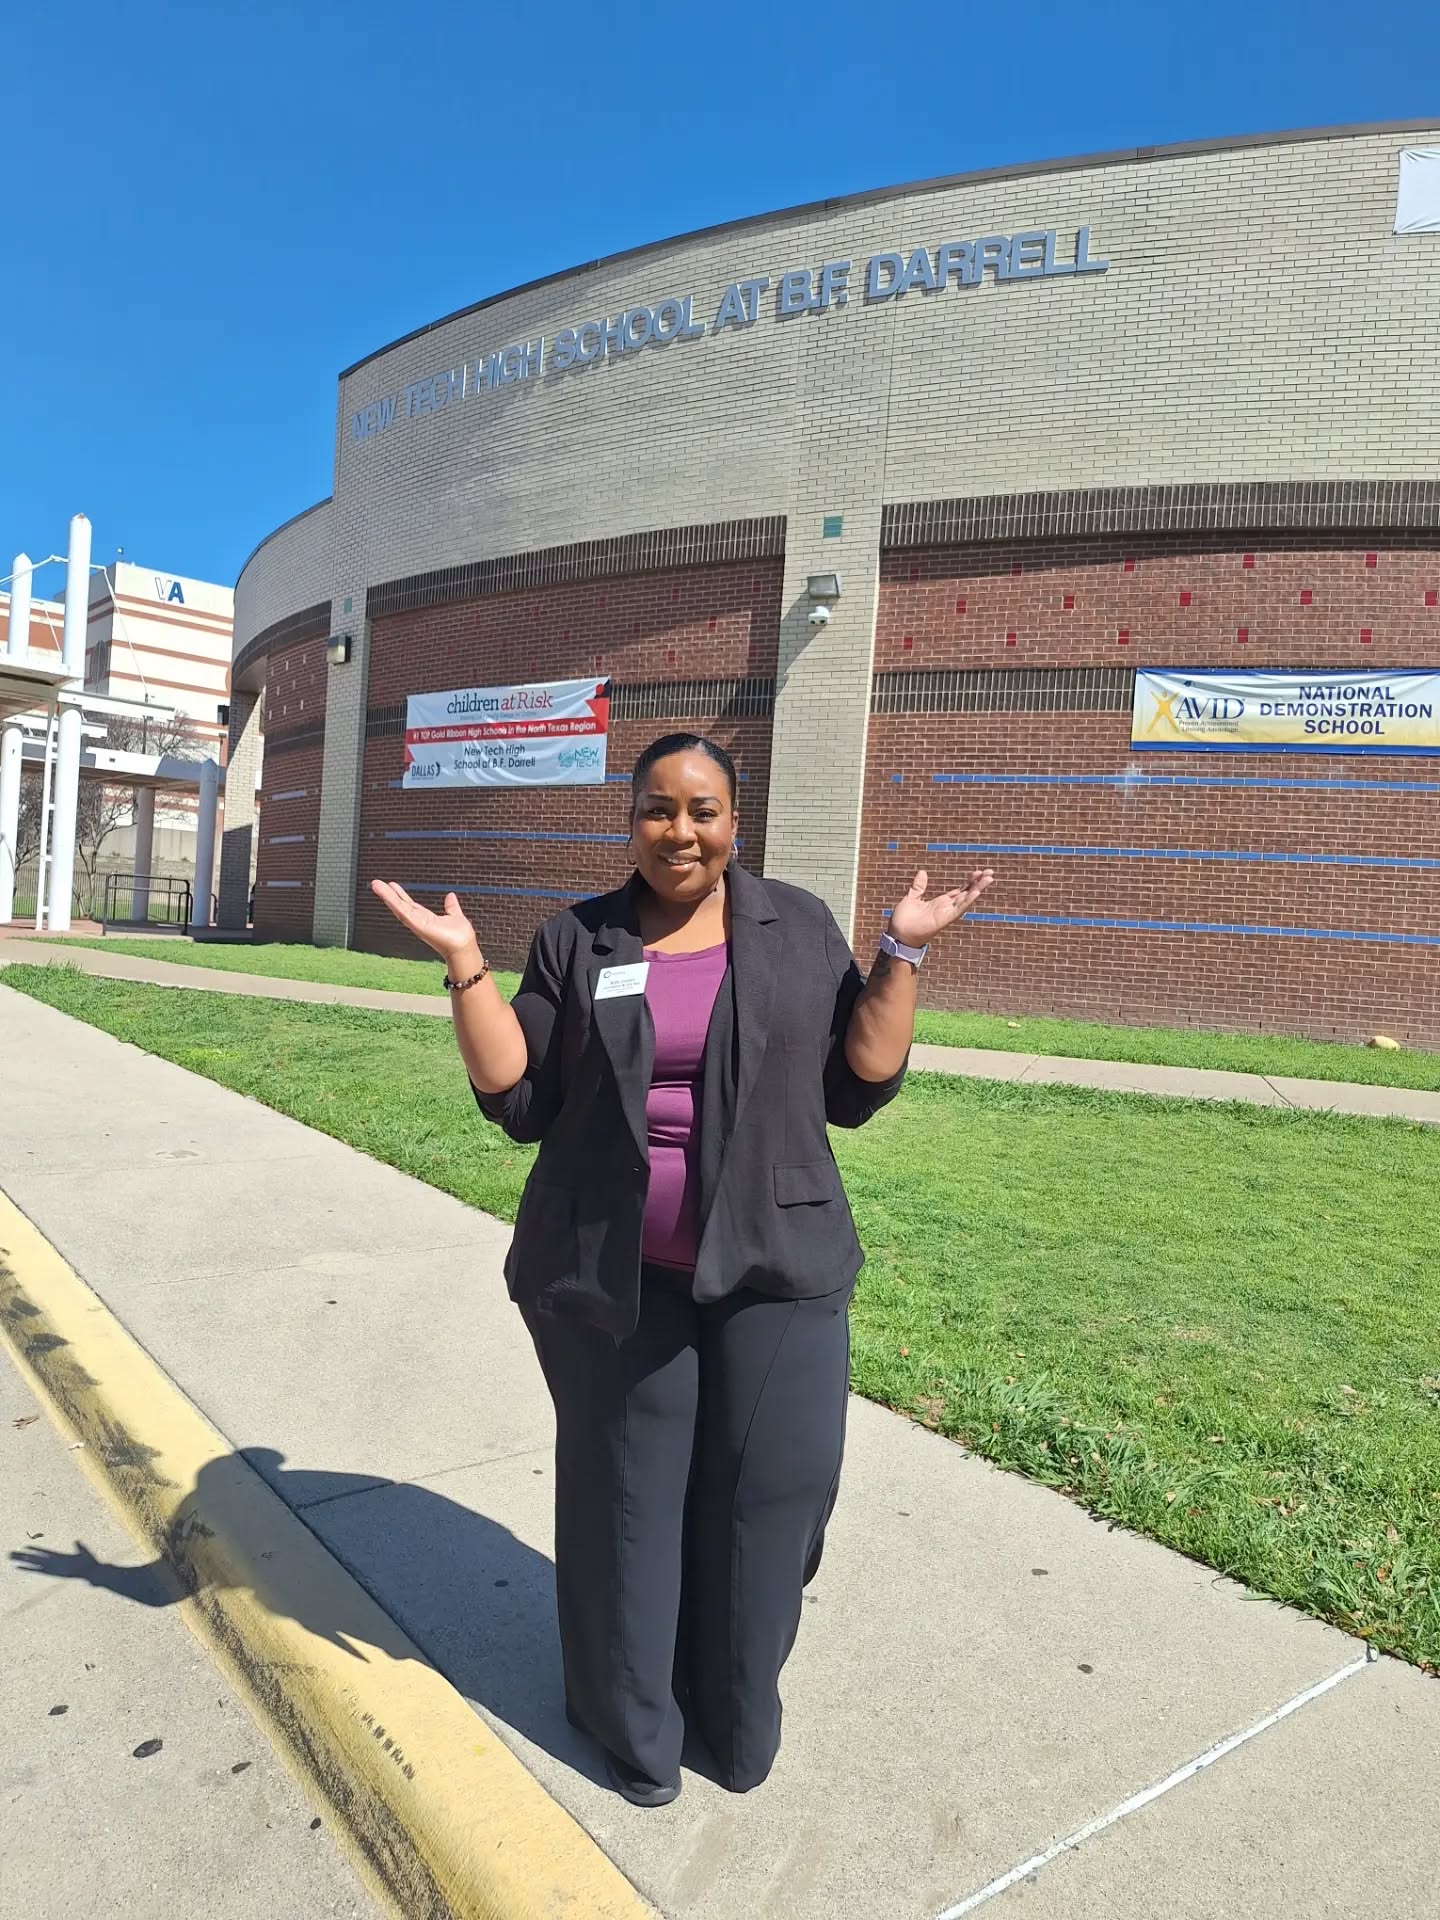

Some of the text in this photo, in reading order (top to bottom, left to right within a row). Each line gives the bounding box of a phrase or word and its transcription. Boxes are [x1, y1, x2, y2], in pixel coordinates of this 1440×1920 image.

[351, 225, 1110, 440] NEW TECH HIGH SCHOOL AT B.F. DARRELL
[154, 576, 185, 604] VA
[1298, 686, 1395, 701] NATIONAL
[446, 692, 499, 714] children
[1175, 696, 1245, 719] AVID
[1259, 702, 1433, 718] DEMONSTRATION
[431, 729, 446, 739] Gold
[446, 728, 467, 738] Ribbon
[467, 727, 482, 738] High
[508, 725, 515, 734] in
[515, 724, 527, 734] the
[528, 723, 546, 733] North
[547, 722, 569, 732] Texas
[570, 720, 597, 733] Region
[1303, 719, 1385, 735] SCHOOL
[464, 743, 526, 758] New Tech High
[574, 746, 600, 758] NEW
[411, 763, 436, 777] DALLAS
[454, 758, 481, 770] School
[508, 756, 536, 769] Darrell
[575, 758, 600, 768] TECH
